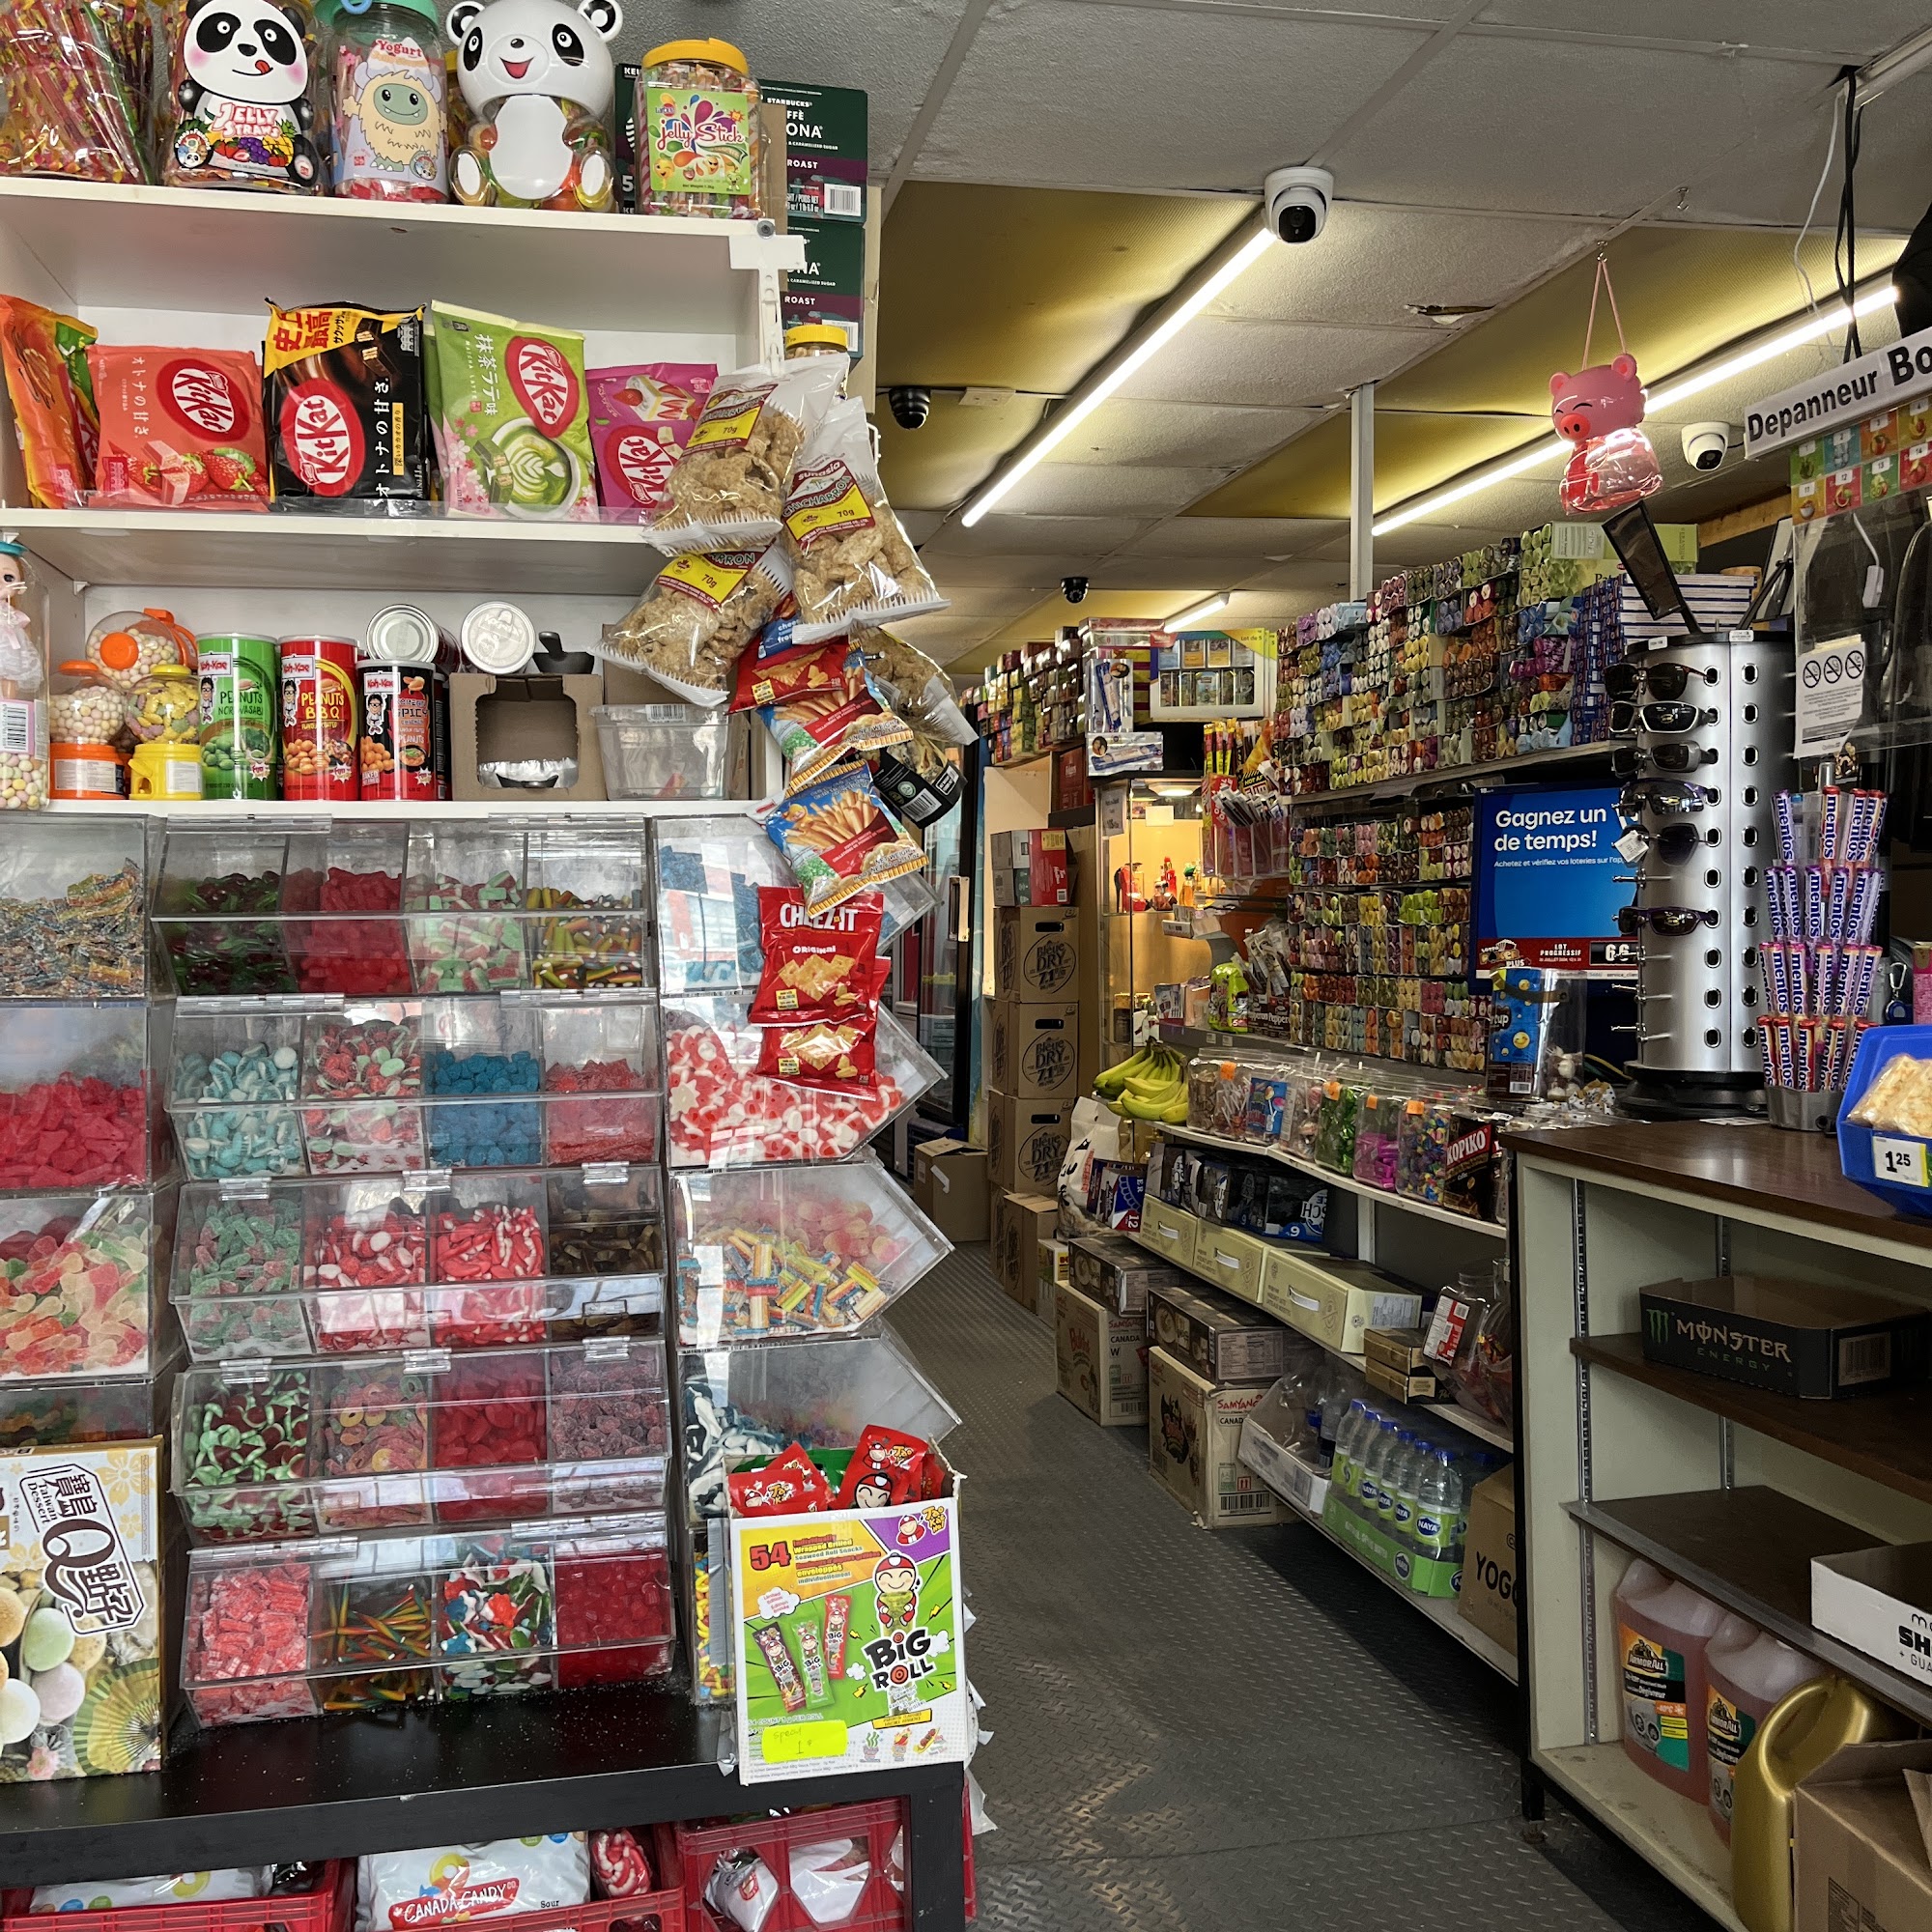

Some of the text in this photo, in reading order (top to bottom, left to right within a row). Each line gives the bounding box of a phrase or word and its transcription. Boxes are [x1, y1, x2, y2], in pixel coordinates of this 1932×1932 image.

[377, 40, 422, 57] Yogurt
[213, 102, 278, 130] JELLY
[222, 121, 281, 137] STRAWS
[657, 118, 744, 150] jelly Stick
[786, 159, 817, 169] ROAST
[784, 296, 815, 305] ROAST
[474, 333, 500, 416] 抹茶ラテ味
[520, 350, 567, 423] KitKat
[176, 373, 234, 434] KitKat
[1747, 371, 1877, 441] Depanneur
[297, 398, 350, 474] KitKat
[723, 425, 737, 434] 70g
[619, 439, 673, 492] KitKat
[798, 461, 841, 481] sunasia
[782, 475, 853, 518] CHICHARRON
[837, 508, 855, 518] 70g
[700, 574, 718, 589] 70g
[220, 691, 263, 705] PENUTS
[301, 692, 345, 706] PENUTS
[1495, 808, 1606, 830] Gagnez un
[1777, 798, 1794, 862] mentos
[1824, 795, 1836, 860] mentos
[1846, 798, 1864, 862] mentos
[1856, 798, 1878, 862] mentos
[1494, 830, 1597, 852] de temps!
[1766, 874, 1783, 937] mentos
[1787, 873, 1801, 937] mentos
[1809, 874, 1821, 938] mentos
[1830, 876, 1845, 940] mentos
[1846, 877, 1867, 940] mentos
[1037, 952, 1065, 972] DRY
[1773, 952, 1788, 1013] mentos
[1792, 953, 1804, 1015] mentos
[1835, 953, 1850, 1015] mentos
[1853, 954, 1875, 1015] mentos
[1036, 1051, 1065, 1069] DRY
[1759, 1027, 1774, 1086] mentos
[1779, 1027, 1794, 1088] mentos
[1799, 1030, 1809, 1091] mentos
[1032, 1147, 1061, 1166] DRY
[1446, 1130, 1486, 1166] KOPIKO
[1128, 1214, 1140, 1229] 12
[1676, 1319, 1792, 1363] MONSTER
[1696, 1347, 1771, 1372] ENERGY
[27, 1482, 50, 1525] Dessert
[39, 1482, 58, 1521] Taiwan
[923, 1506, 945, 1520] Tao
[1417, 1520, 1438, 1532] NAYA
[750, 1541, 792, 1572] 54
[794, 1538, 853, 1554] Wrapped Grilled
[795, 1549, 825, 1561] Seaweed
[839, 1546, 863, 1554] Snacks
[1476, 1551, 1518, 1608] YOG
[864, 1630, 932, 1671] BiG
[871, 1658, 935, 1690] ROLL
[404, 1884, 506, 1922] CANADA CANDY
[540, 1899, 560, 1909] Sour
